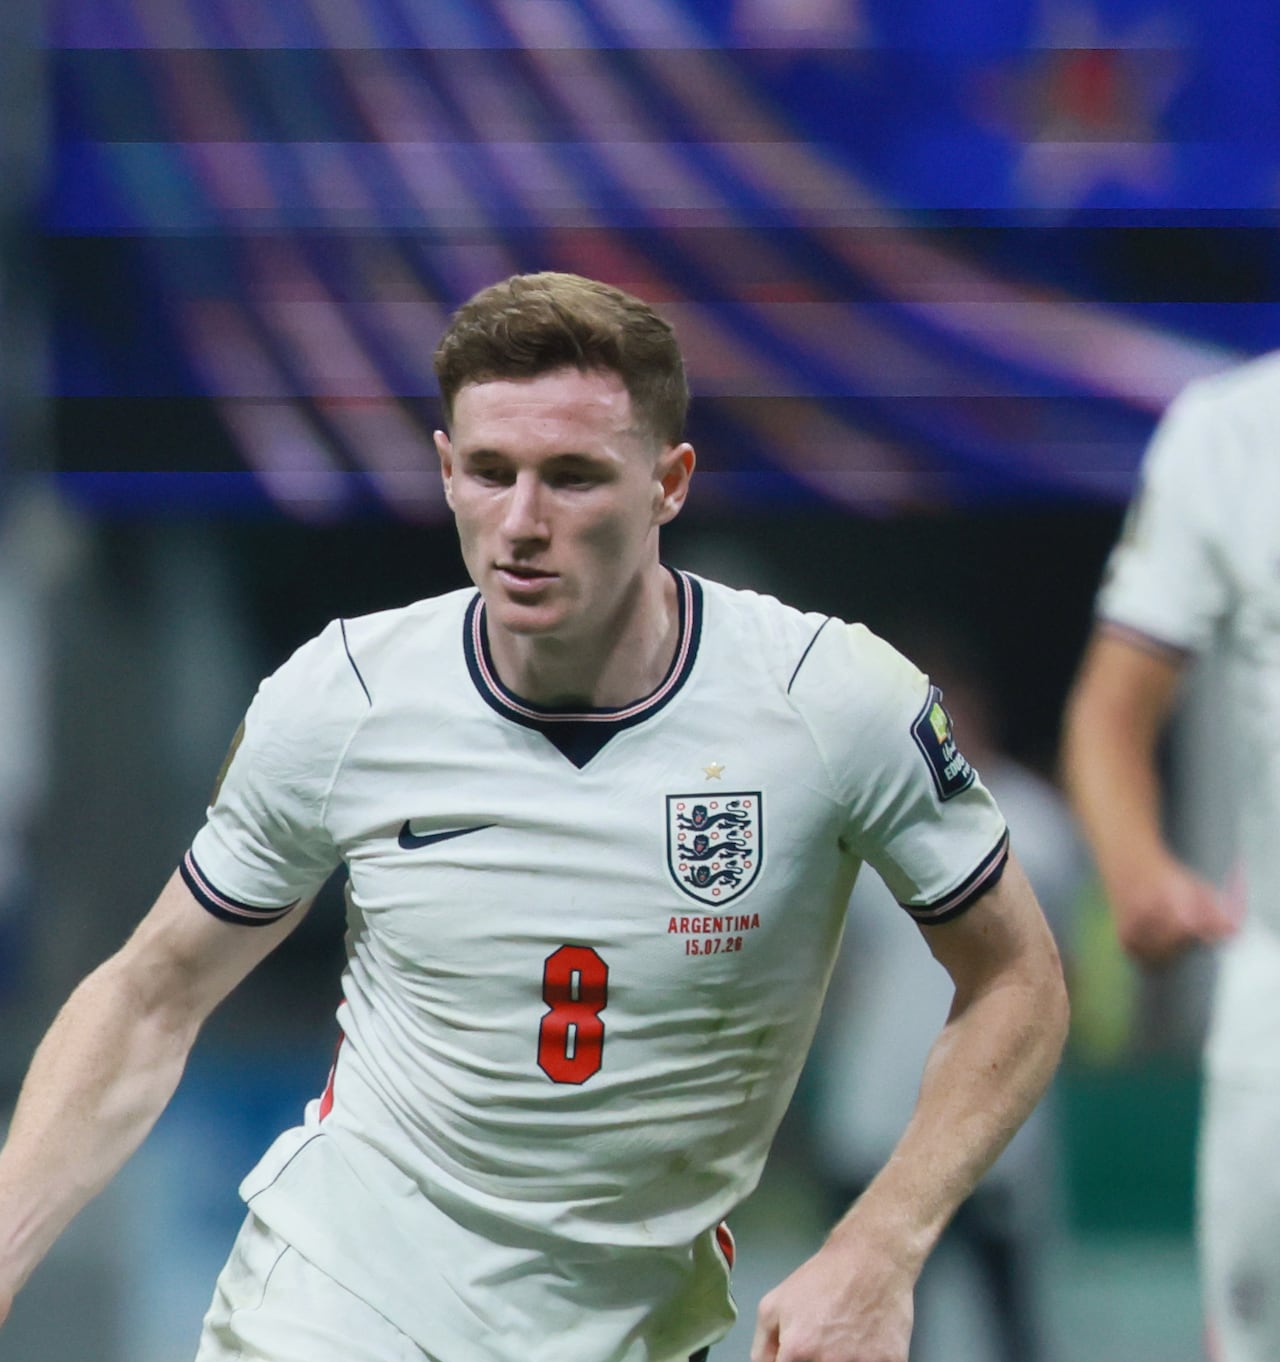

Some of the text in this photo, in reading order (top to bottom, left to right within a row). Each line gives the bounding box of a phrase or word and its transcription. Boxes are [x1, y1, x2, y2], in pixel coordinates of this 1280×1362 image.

[668, 913, 760, 934] ARGENTINA
[685, 937, 743, 956] 15.07.26
[536, 944, 609, 1085] 8
